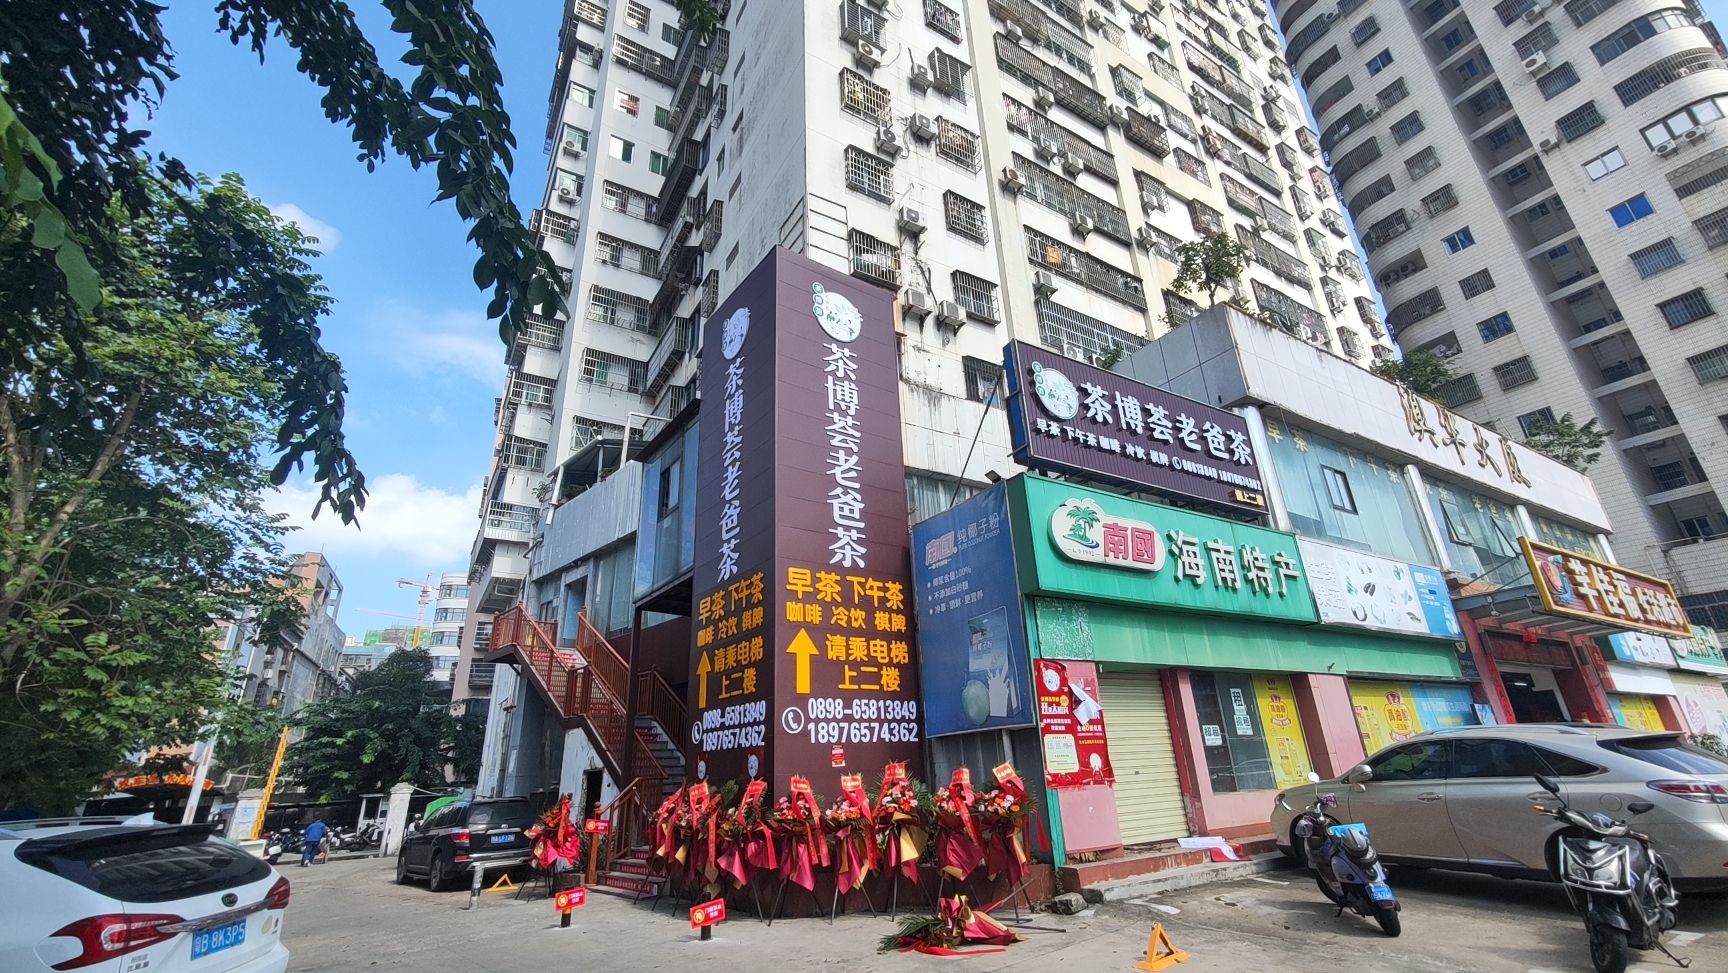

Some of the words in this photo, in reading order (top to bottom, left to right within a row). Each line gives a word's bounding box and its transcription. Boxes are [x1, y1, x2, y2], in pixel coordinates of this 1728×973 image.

[1081, 381, 1253, 466] 茶博荟老爸茶
[717, 356, 745, 583] 茶博荟老爸茶
[823, 343, 867, 568] 茶博荟老爸茶
[958, 512, 1000, 544] 纯椰子粉
[1166, 528, 1301, 598] 海南特产
[698, 590, 726, 625] 早茶
[728, 572, 764, 611] 下午茶
[786, 567, 842, 602] 早茶
[846, 575, 904, 610] 下午茶
[697, 625, 715, 647] 咖啡
[718, 616, 737, 640] 冷饮
[742, 606, 764, 632] 棋牌
[786, 602, 822, 624] 咖啡
[831, 606, 866, 629] 冷饮
[874, 610, 906, 633] 棋牌
[714, 636, 764, 672] 请乘电梯
[826, 634, 909, 664] 请乘电梯
[718, 668, 756, 700] 上二楼
[838, 665, 901, 692] 上二楼
[703, 700, 766, 731] 0898-65813849
[808, 698, 917, 720] 0898-65813849
[702, 725, 765, 751] 18976574362
[808, 722, 918, 744] 18976574362
